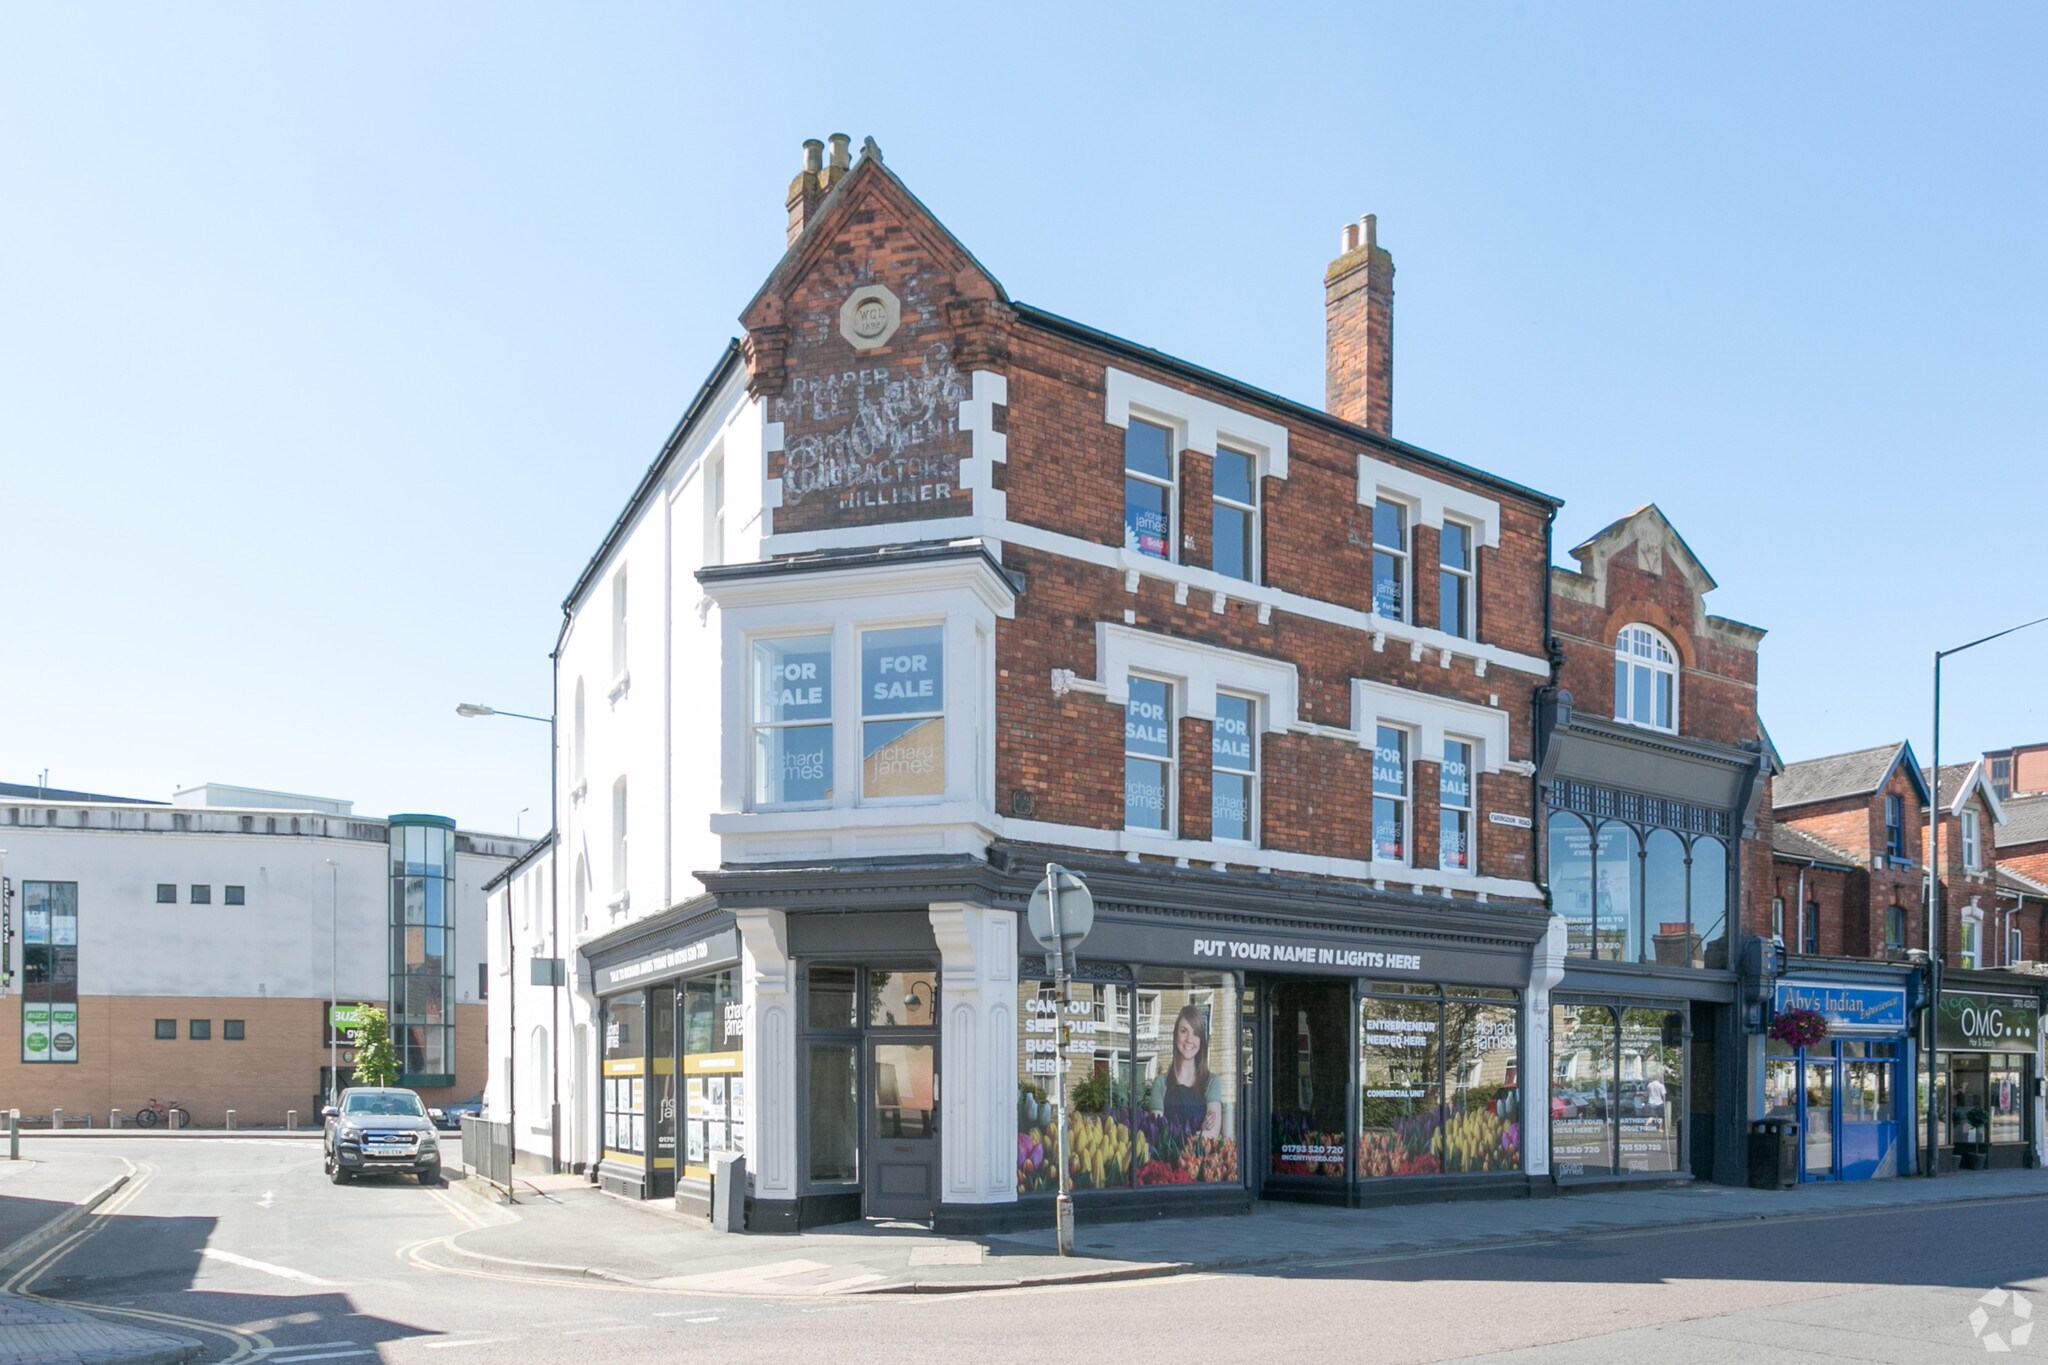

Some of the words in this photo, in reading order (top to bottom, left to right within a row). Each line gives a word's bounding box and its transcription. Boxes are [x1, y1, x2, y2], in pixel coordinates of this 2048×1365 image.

[839, 483, 951, 509] MILLINER
[1136, 512, 1167, 534] james
[1147, 537, 1164, 549] Sold
[773, 662, 816, 681] FOR
[880, 654, 928, 674] FOR
[764, 687, 822, 706] SALE
[873, 679, 934, 700] SALE
[1130, 700, 1164, 721] FOR
[1125, 722, 1167, 744] SALE
[1215, 717, 1248, 736] FOR
[874, 742, 934, 761] richard
[1212, 738, 1251, 758] SALE
[1375, 747, 1401, 764] FOR
[872, 757, 935, 783] james
[1372, 766, 1403, 784] SALE
[1442, 760, 1467, 777] FOR
[1440, 779, 1469, 796] SALE
[1126, 793, 1166, 810] ames
[1212, 793, 1248, 810] ichard
[1212, 806, 1248, 822] ames
[1440, 827, 1466, 841] chard
[1440, 838, 1466, 853] ames
[1193, 939, 1226, 957] PUT
[1228, 941, 1271, 960] YOUR
[1273, 945, 1316, 963] NAME
[1318, 948, 1333, 964] IN
[1335, 950, 1384, 967] LIGHTS
[1386, 953, 1421, 970] HERE
[1604, 942, 1621, 950] 720
[1025, 999, 1056, 1013] CAN
[1064, 1000, 1091, 1014] OU
[1826, 989, 1863, 1012] Indian
[1025, 1019, 1054, 1033] SEE
[1065, 1020, 1096, 1034] OUR
[1366, 1019, 1436, 1033] ENTREPRENEUR
[1476, 1019, 1515, 1035] richard
[1025, 1039, 1096, 1053] BUSESS
[1138, 1043, 1174, 1051] LOCATIO
[1366, 1034, 1403, 1047] NEEDED
[1404, 1035, 1427, 1047] HERE
[1474, 1034, 1516, 1057] james
[1366, 1090, 1409, 1098] COMMERCIAL
[1409, 1090, 1425, 1098] UNIT
[1567, 1118, 1582, 1126] SEE
[1583, 1118, 1604, 1126] YOUR
[1281, 1144, 1307, 1153] 01793
[1308, 1145, 1325, 1153] 520
[1326, 1146, 1344, 1154] 720
[1648, 1143, 1662, 1151] 720
[1281, 1154, 1344, 1163] INCENTIVISED.COM
